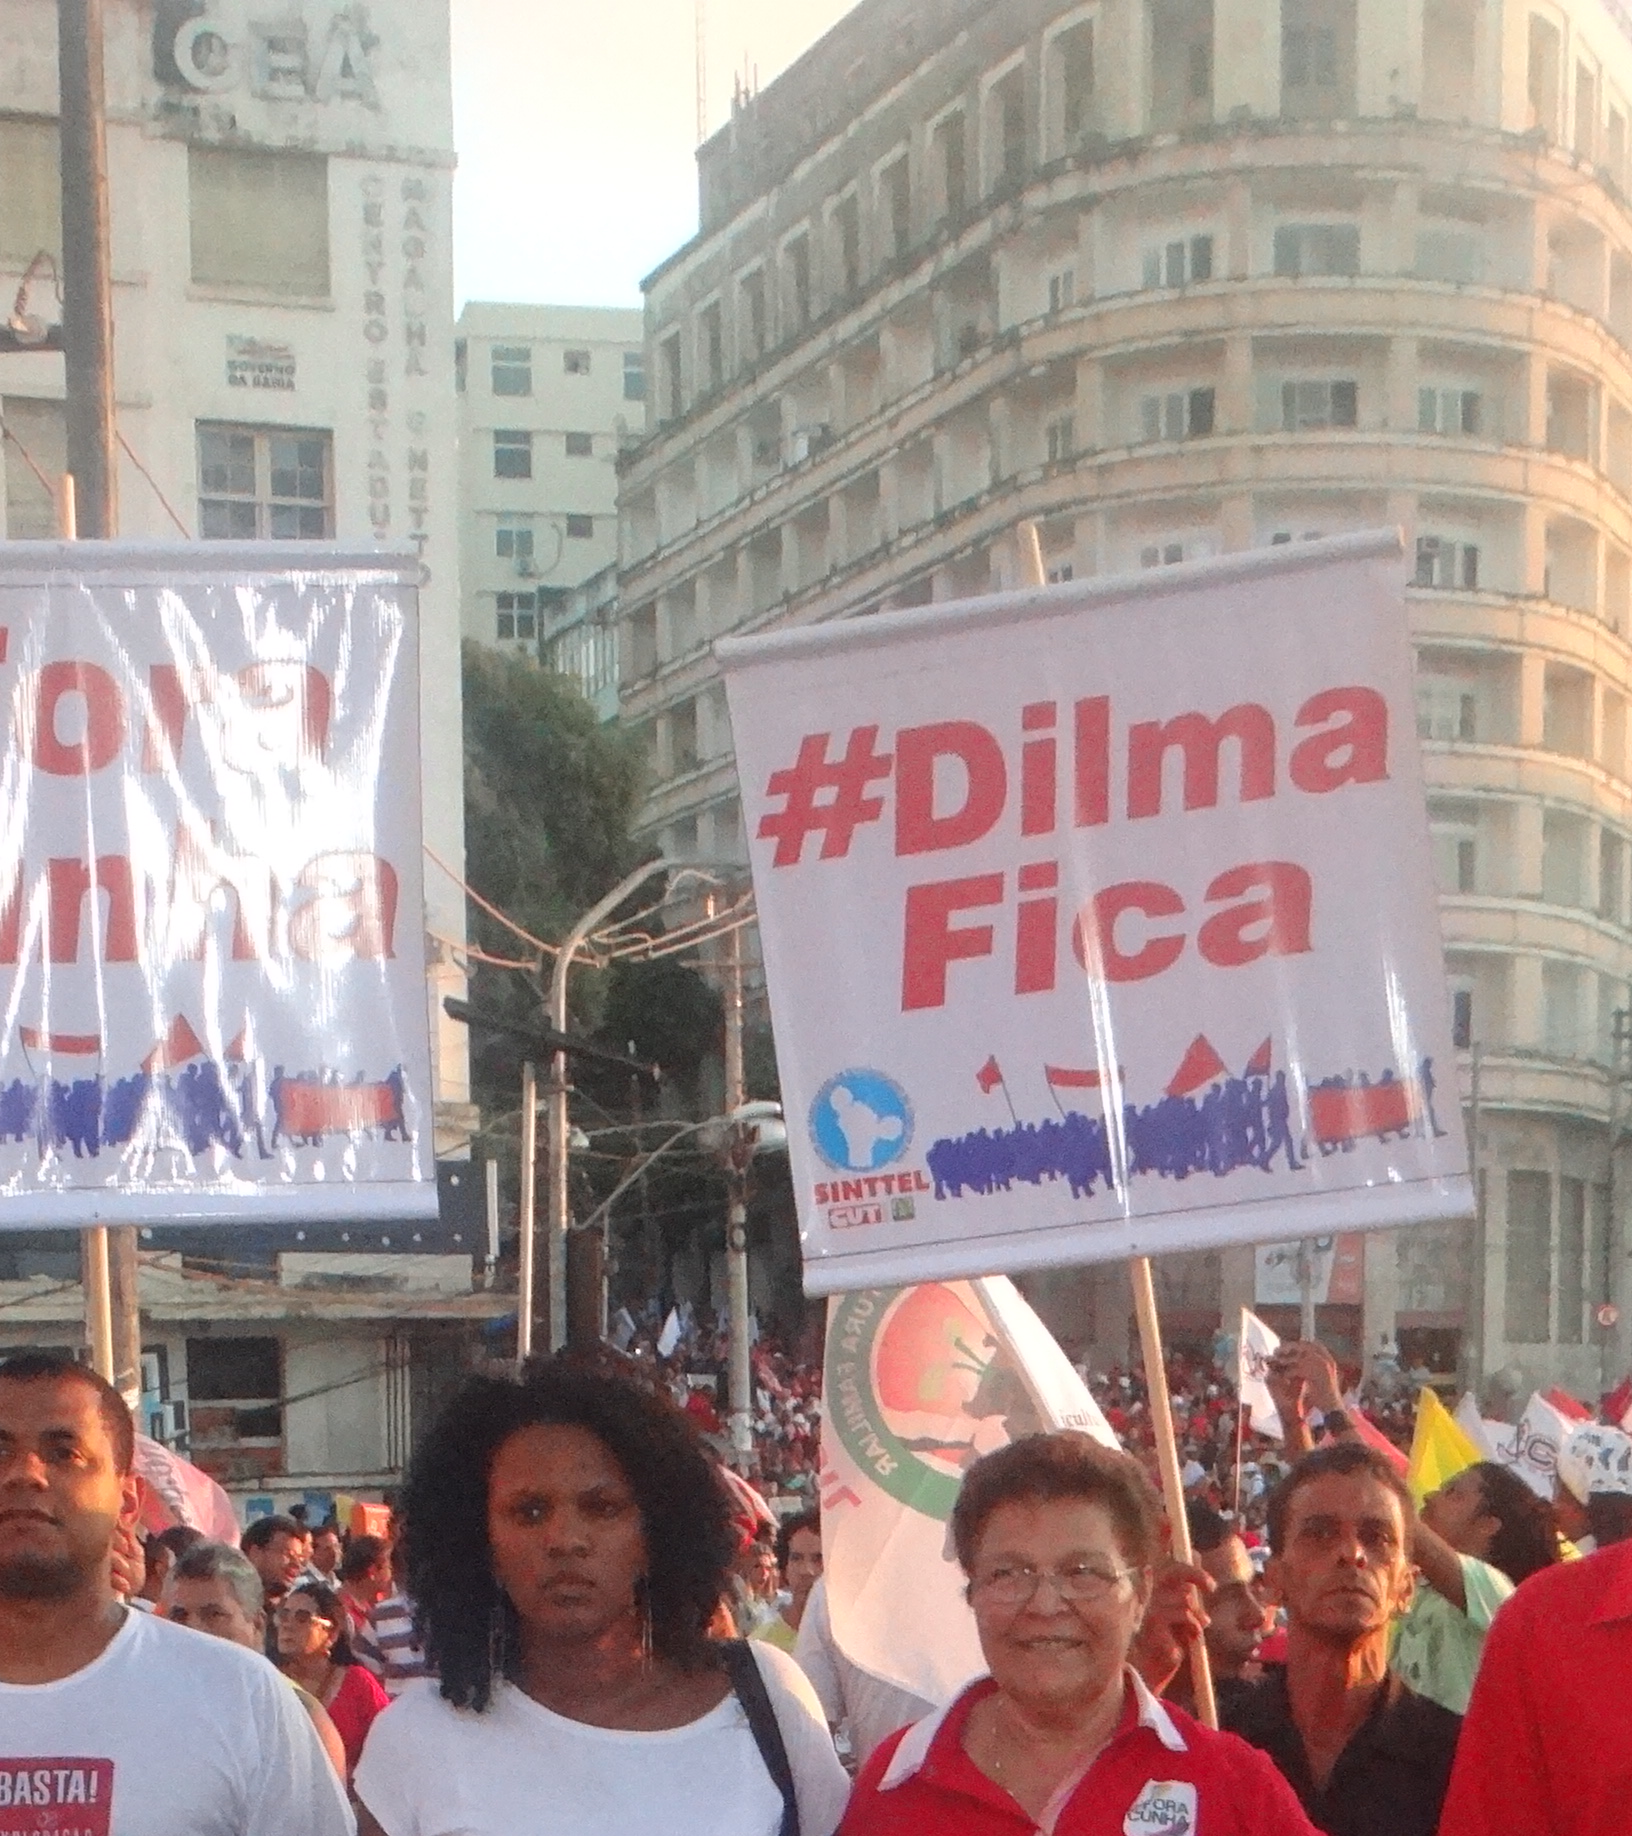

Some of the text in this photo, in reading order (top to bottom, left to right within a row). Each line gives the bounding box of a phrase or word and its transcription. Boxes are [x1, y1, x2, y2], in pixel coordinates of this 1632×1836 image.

[172, 12, 380, 103] CEA
[755, 685, 1390, 869] #Dilma
[901, 860, 1313, 1012] Fica
[814, 1170, 930, 1205] SINTTEL
[828, 1203, 882, 1230] CUT
